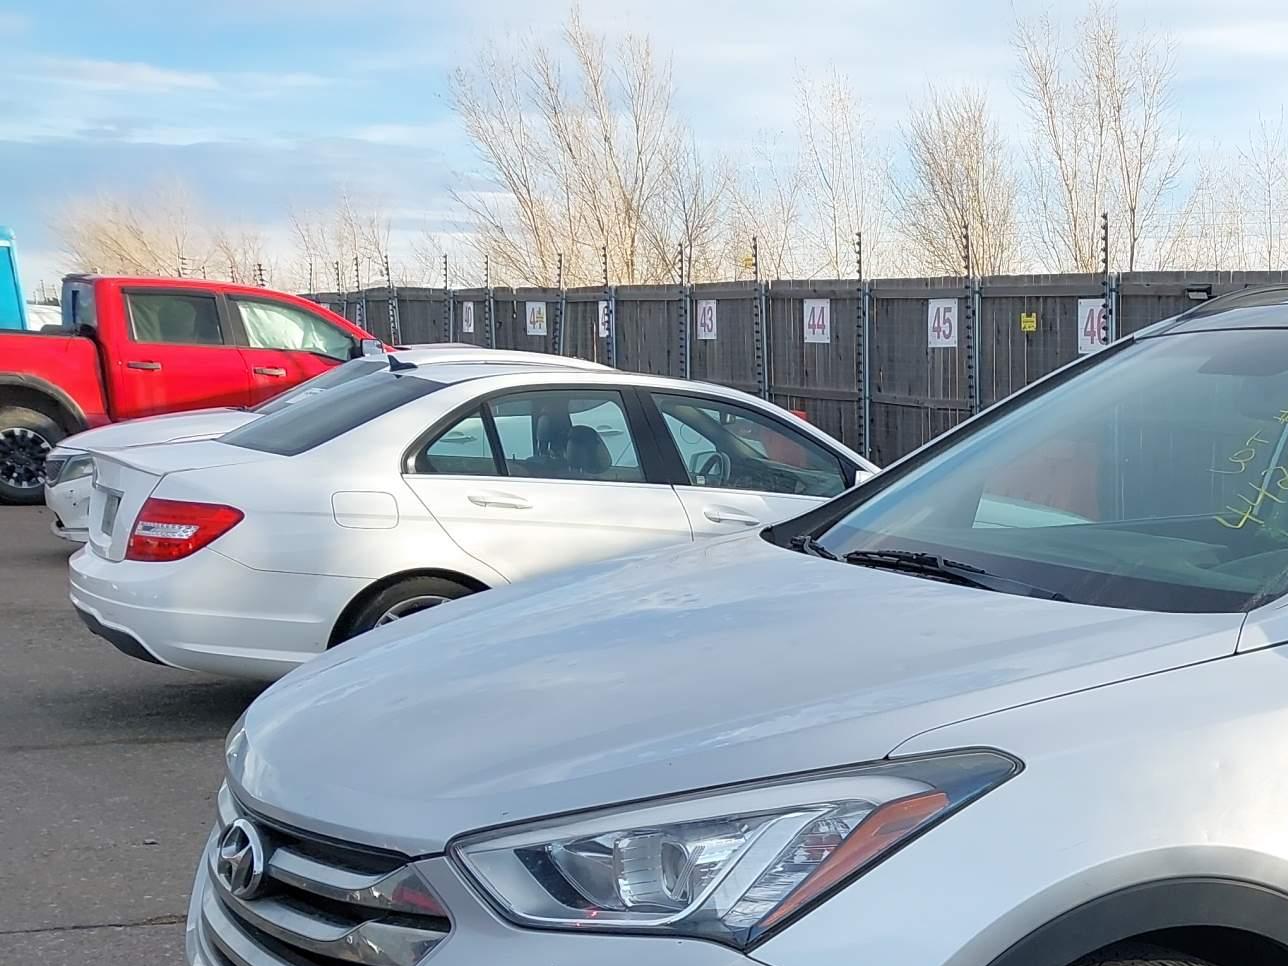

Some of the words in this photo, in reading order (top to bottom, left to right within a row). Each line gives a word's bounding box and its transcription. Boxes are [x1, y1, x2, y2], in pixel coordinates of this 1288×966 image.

[700, 305, 713, 333] 43
[808, 306, 826, 335] 44
[932, 306, 953, 340] 45
